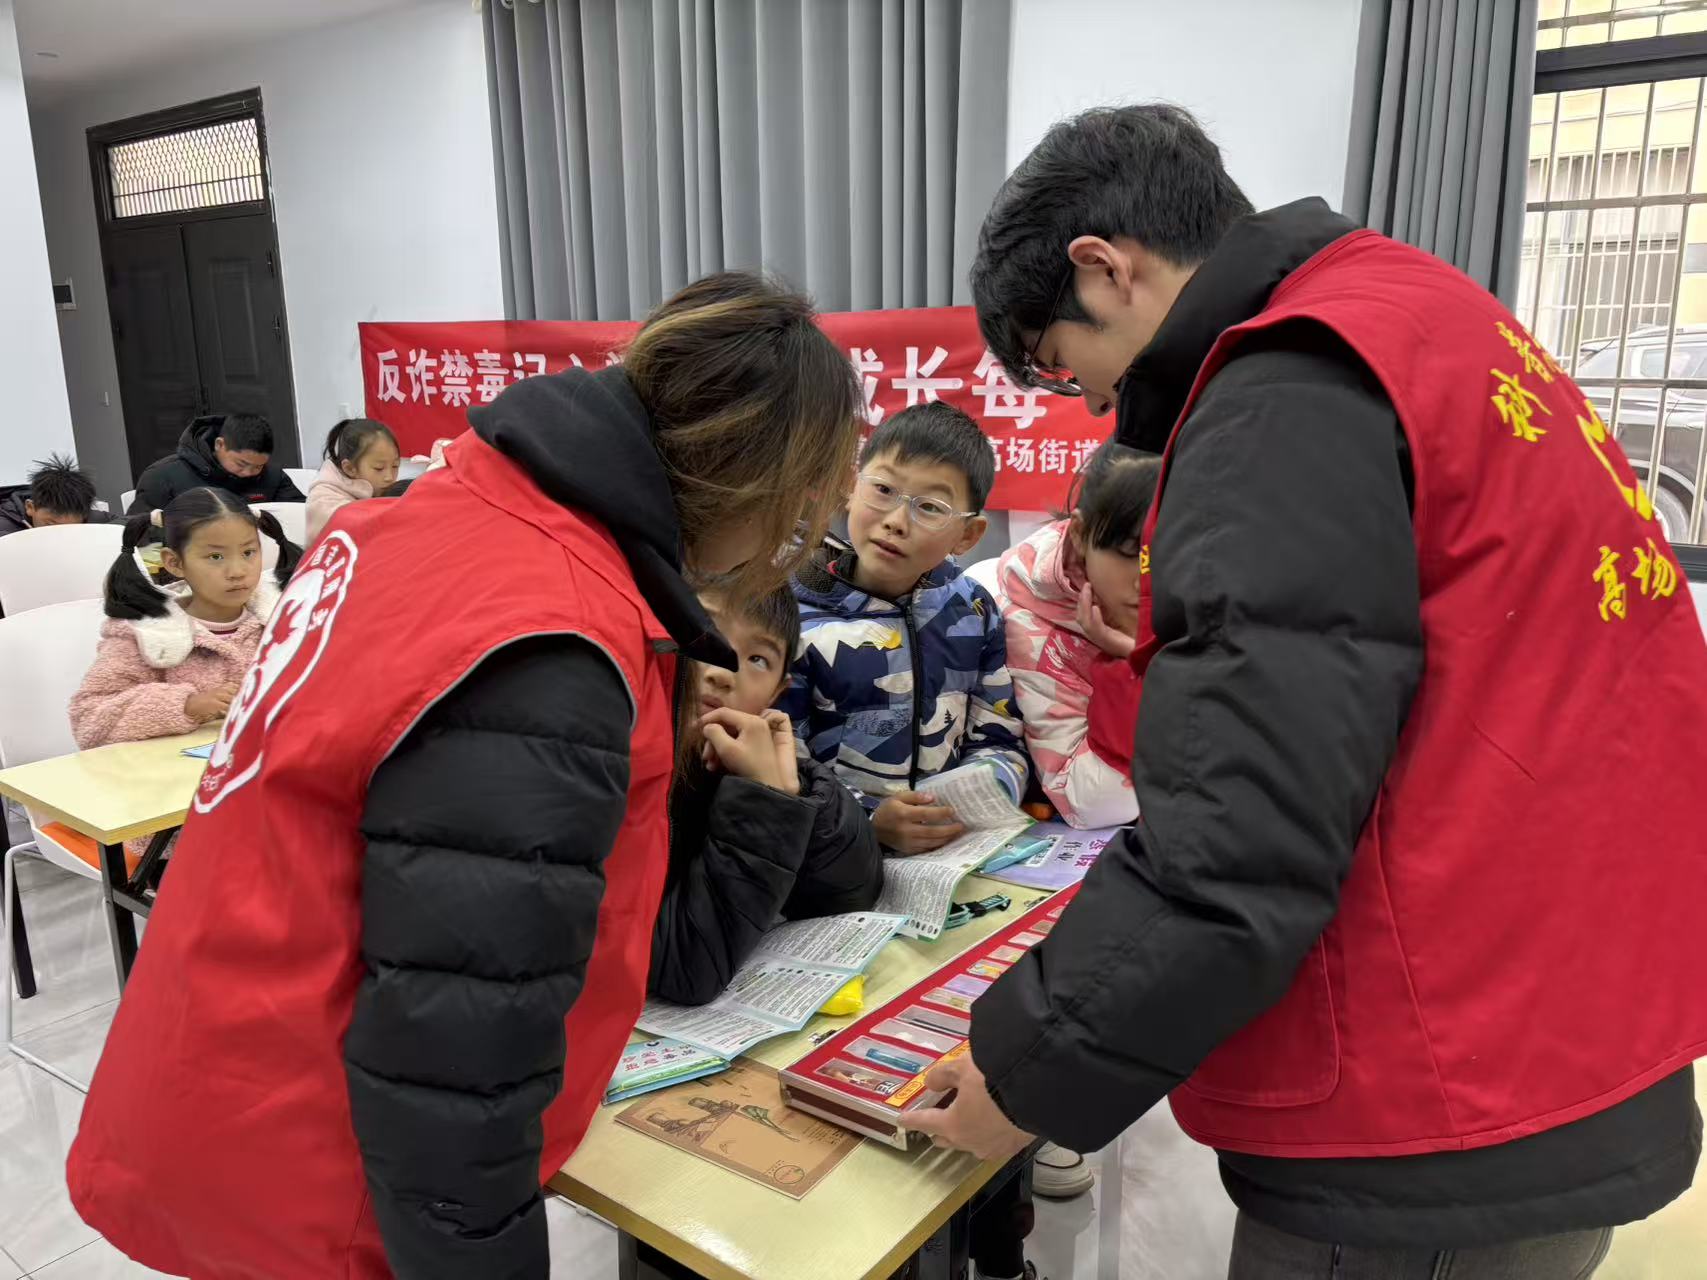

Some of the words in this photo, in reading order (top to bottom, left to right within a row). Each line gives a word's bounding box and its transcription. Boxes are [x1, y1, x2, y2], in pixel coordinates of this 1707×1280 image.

[376, 348, 629, 408] 反诈禁毒记
